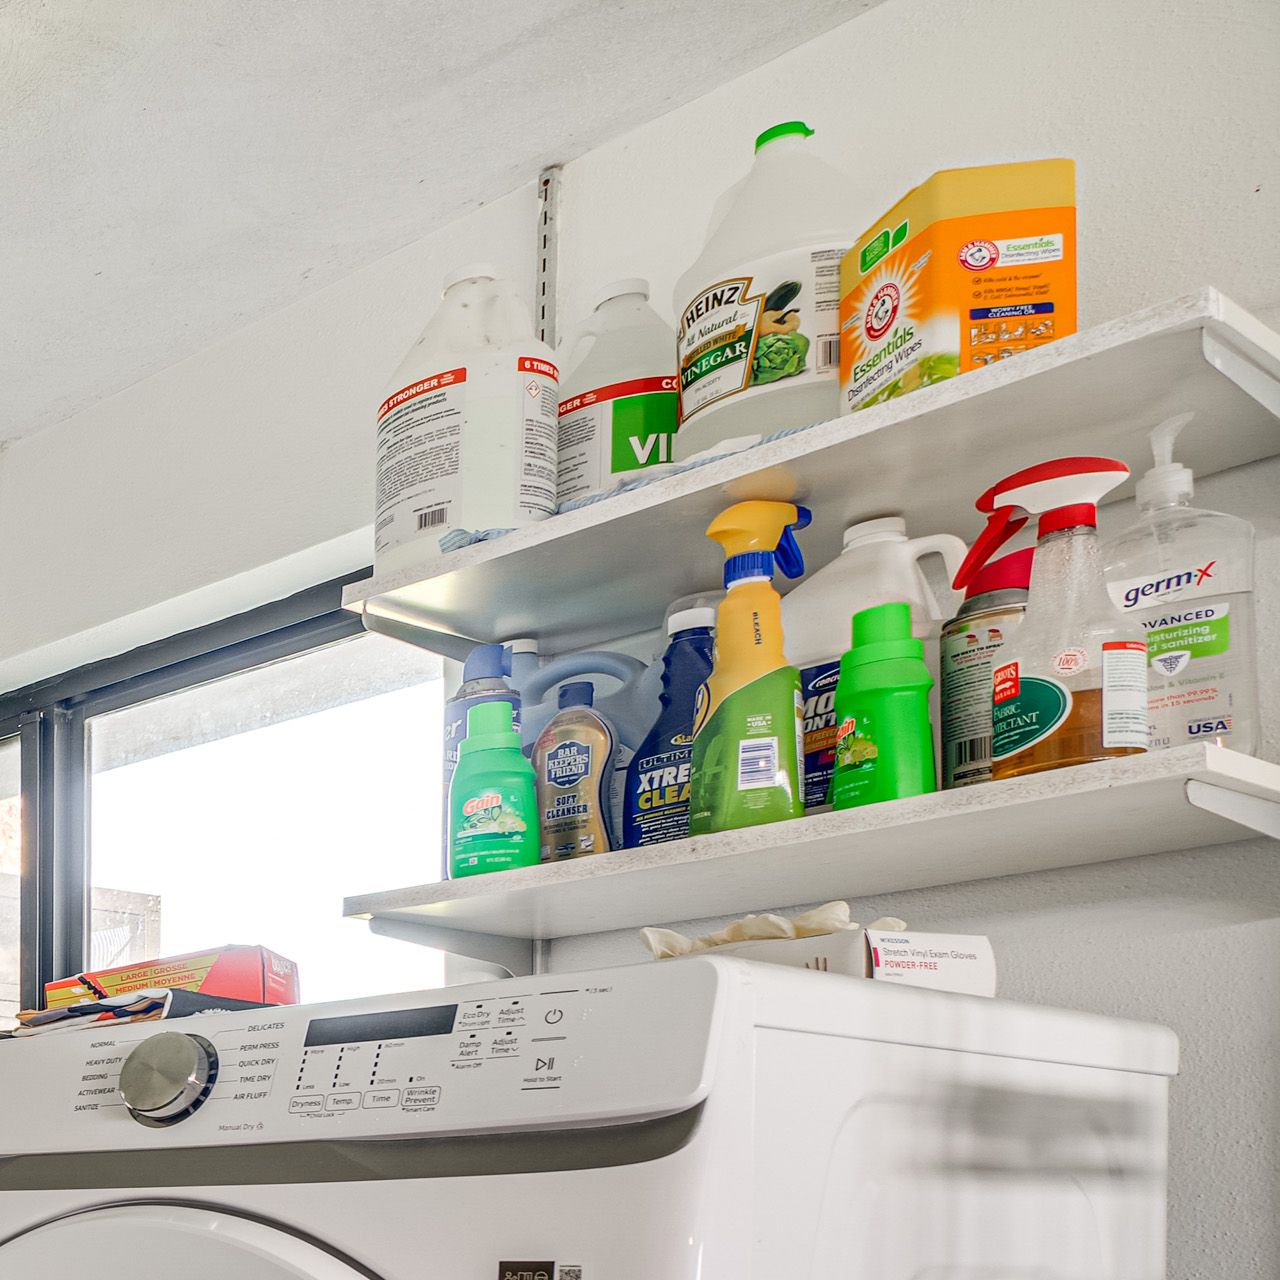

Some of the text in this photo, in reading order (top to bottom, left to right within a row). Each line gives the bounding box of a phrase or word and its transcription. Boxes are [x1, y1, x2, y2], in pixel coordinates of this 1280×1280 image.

[1007, 238, 1055, 252] Essentials
[686, 286, 740, 329] HEINZ
[988, 310, 1023, 318] CLEANING
[697, 311, 739, 342] Natural
[711, 331, 737, 349] WHITE
[854, 326, 914, 383] Essentials
[524, 360, 554, 375] 6 TIMES
[681, 341, 746, 385] VINEGAR
[847, 339, 923, 402] Disinfecting Wipes
[388, 378, 439, 408] STRONGER
[752, 611, 763, 646] BLEACH
[1161, 633, 1217, 651] sanitizer
[1187, 720, 1228, 735] USA
[558, 746, 578, 759] BAR
[548, 754, 589, 770] KEEPERS
[551, 763, 585, 779] FRIEND
[463, 793, 502, 816] Gain
[556, 794, 577, 807] SOFT
[546, 804, 589, 820] CLEANSER
[882, 947, 978, 961] Stretch Vinyl Exam Gloves
[884, 960, 939, 971] POWDER-FREE
[120, 962, 188, 983] LARGE GROSSE
[115, 973, 196, 995] MEDIUM MOYENNE
[462, 1010, 491, 1020] Eco Dry
[498, 1007, 525, 1016] Adjust
[497, 1016, 515, 1024] Time
[247, 1022, 285, 1032] DELICATES
[90, 1040, 117, 1049] NORMAL
[239, 1041, 280, 1052] PERM PRESS
[459, 1040, 482, 1049] Damp
[492, 1037, 518, 1046] Adjust
[459, 1049, 479, 1057] Alert
[491, 1047, 511, 1055] Time
[85, 1056, 123, 1067] HEAVY DUTY
[238, 1057, 276, 1069] QUICK DRY
[81, 1073, 109, 1082] BEDDING
[239, 1073, 272, 1084] TIME DRY
[78, 1087, 116, 1097] ACTIVEWEAR
[244, 1091, 269, 1100] FLUFF
[406, 1088, 437, 1097] Wrinkle
[291, 1099, 321, 1109] Dryness
[371, 1095, 391, 1103] Time
[404, 1096, 436, 1105] Prevent
[74, 1103, 99, 1112] SANITIZE
[218, 1122, 255, 1132] Manual Dry
